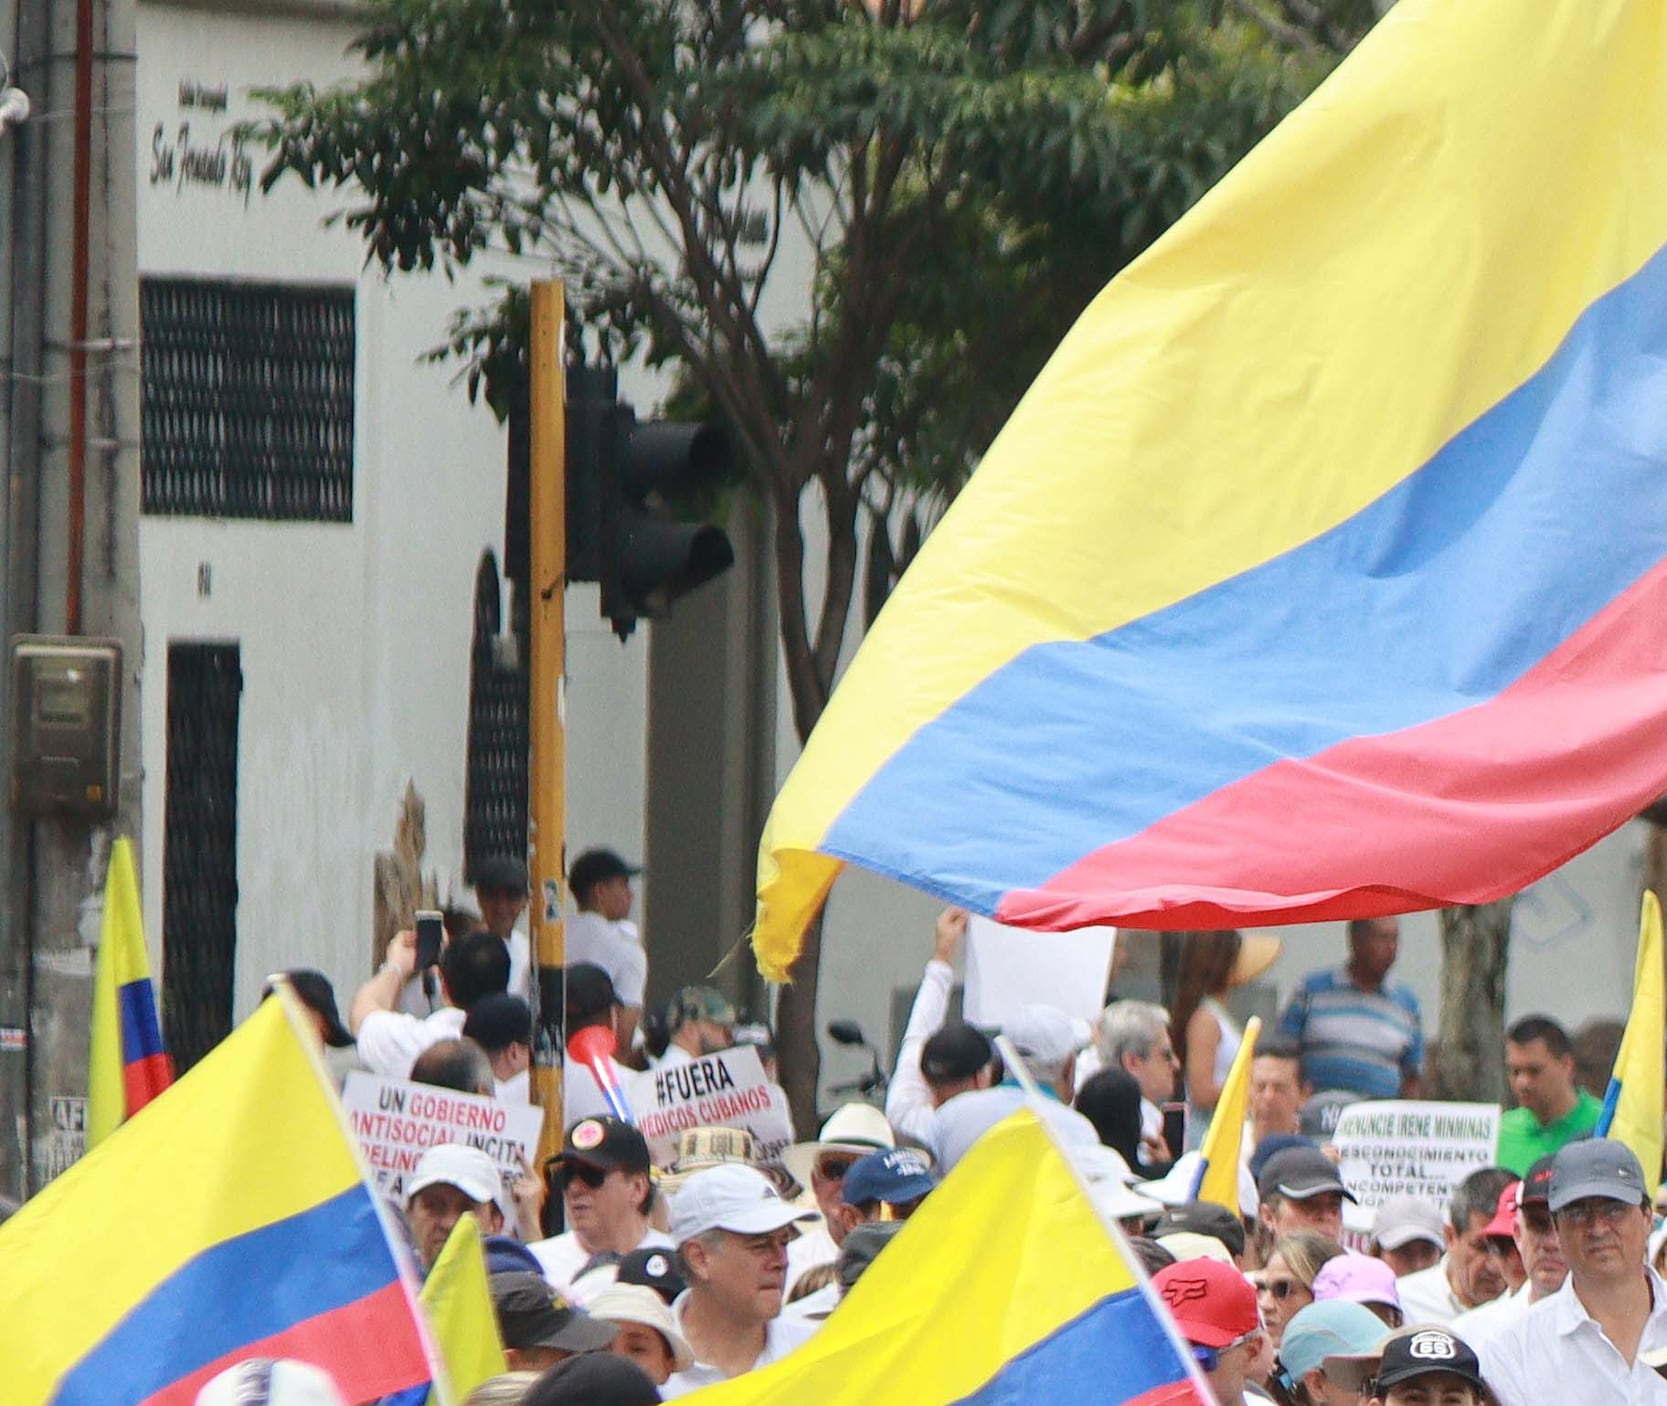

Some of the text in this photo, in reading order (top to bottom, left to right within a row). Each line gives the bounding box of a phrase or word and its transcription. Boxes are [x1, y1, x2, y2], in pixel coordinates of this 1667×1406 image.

[655, 1056, 734, 1107] #FUERA
[379, 1086, 506, 1133] UN GOBIERNO
[700, 1085, 772, 1124] CUBANOS
[1399, 1113, 1430, 1139] IRENE
[1340, 1144, 1489, 1163] ESCONOCIMIENTO
[1419, 1341, 1449, 1355] 66
